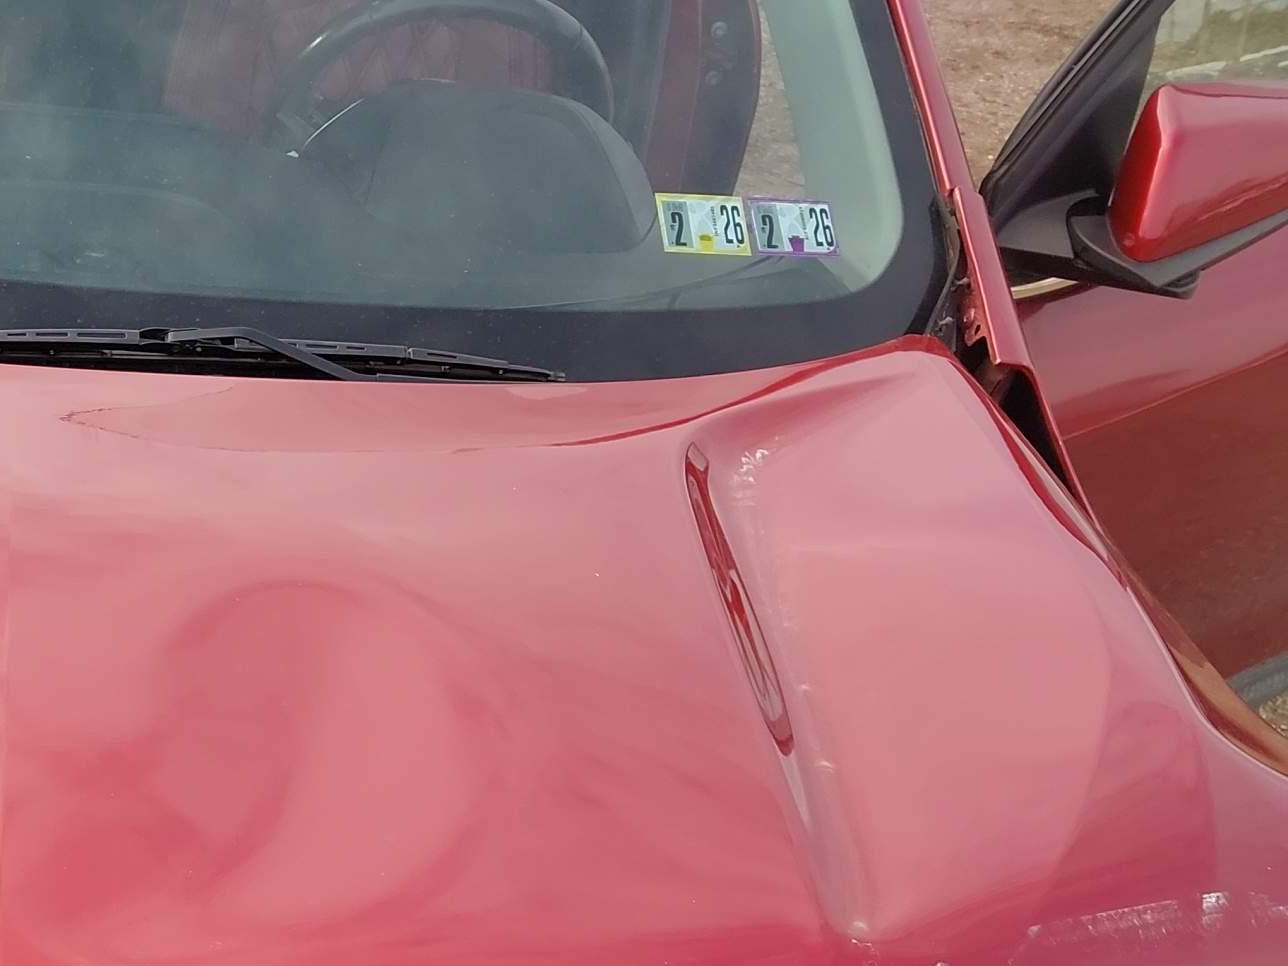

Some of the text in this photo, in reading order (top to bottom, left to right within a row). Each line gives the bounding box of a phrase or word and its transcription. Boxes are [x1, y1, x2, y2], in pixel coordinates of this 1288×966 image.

[670, 211, 687, 246] 2
[720, 204, 745, 245] 26
[761, 214, 779, 249] 2
[809, 207, 834, 247] 26
